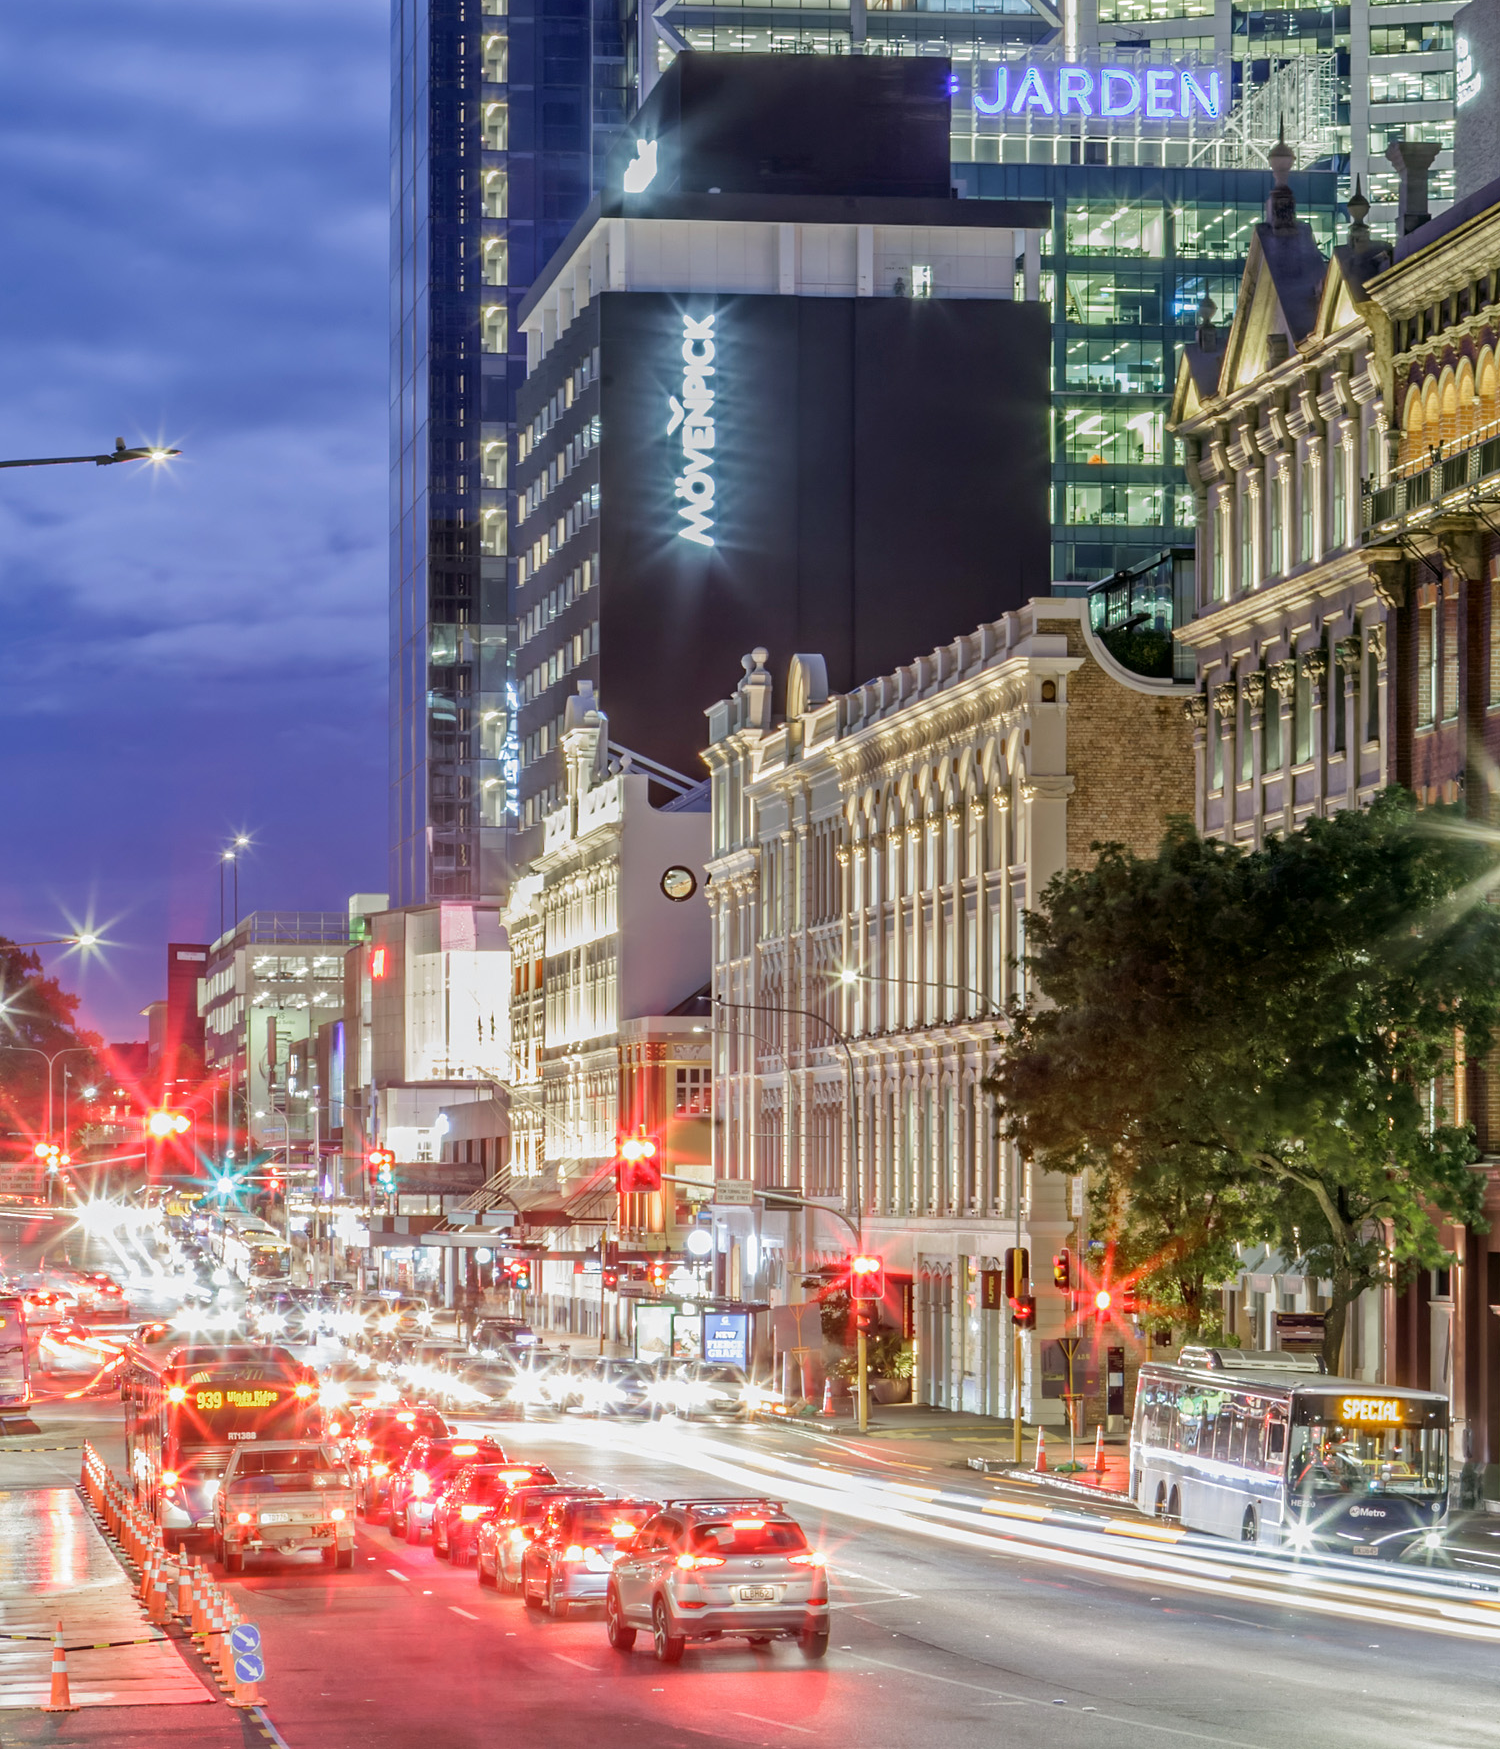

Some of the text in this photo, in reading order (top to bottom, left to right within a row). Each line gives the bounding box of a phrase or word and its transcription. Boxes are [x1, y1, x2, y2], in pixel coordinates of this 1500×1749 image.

[973, 65, 1220, 120] JARDEN
[668, 314, 716, 548] MÖVENPICK
[715, 1331, 737, 1339] NEW
[708, 1349, 743, 1358] GRAPE
[196, 1391, 223, 1409] 939
[1342, 1399, 1402, 1422] SPECIAL
[1360, 1507, 1386, 1518] Metro
